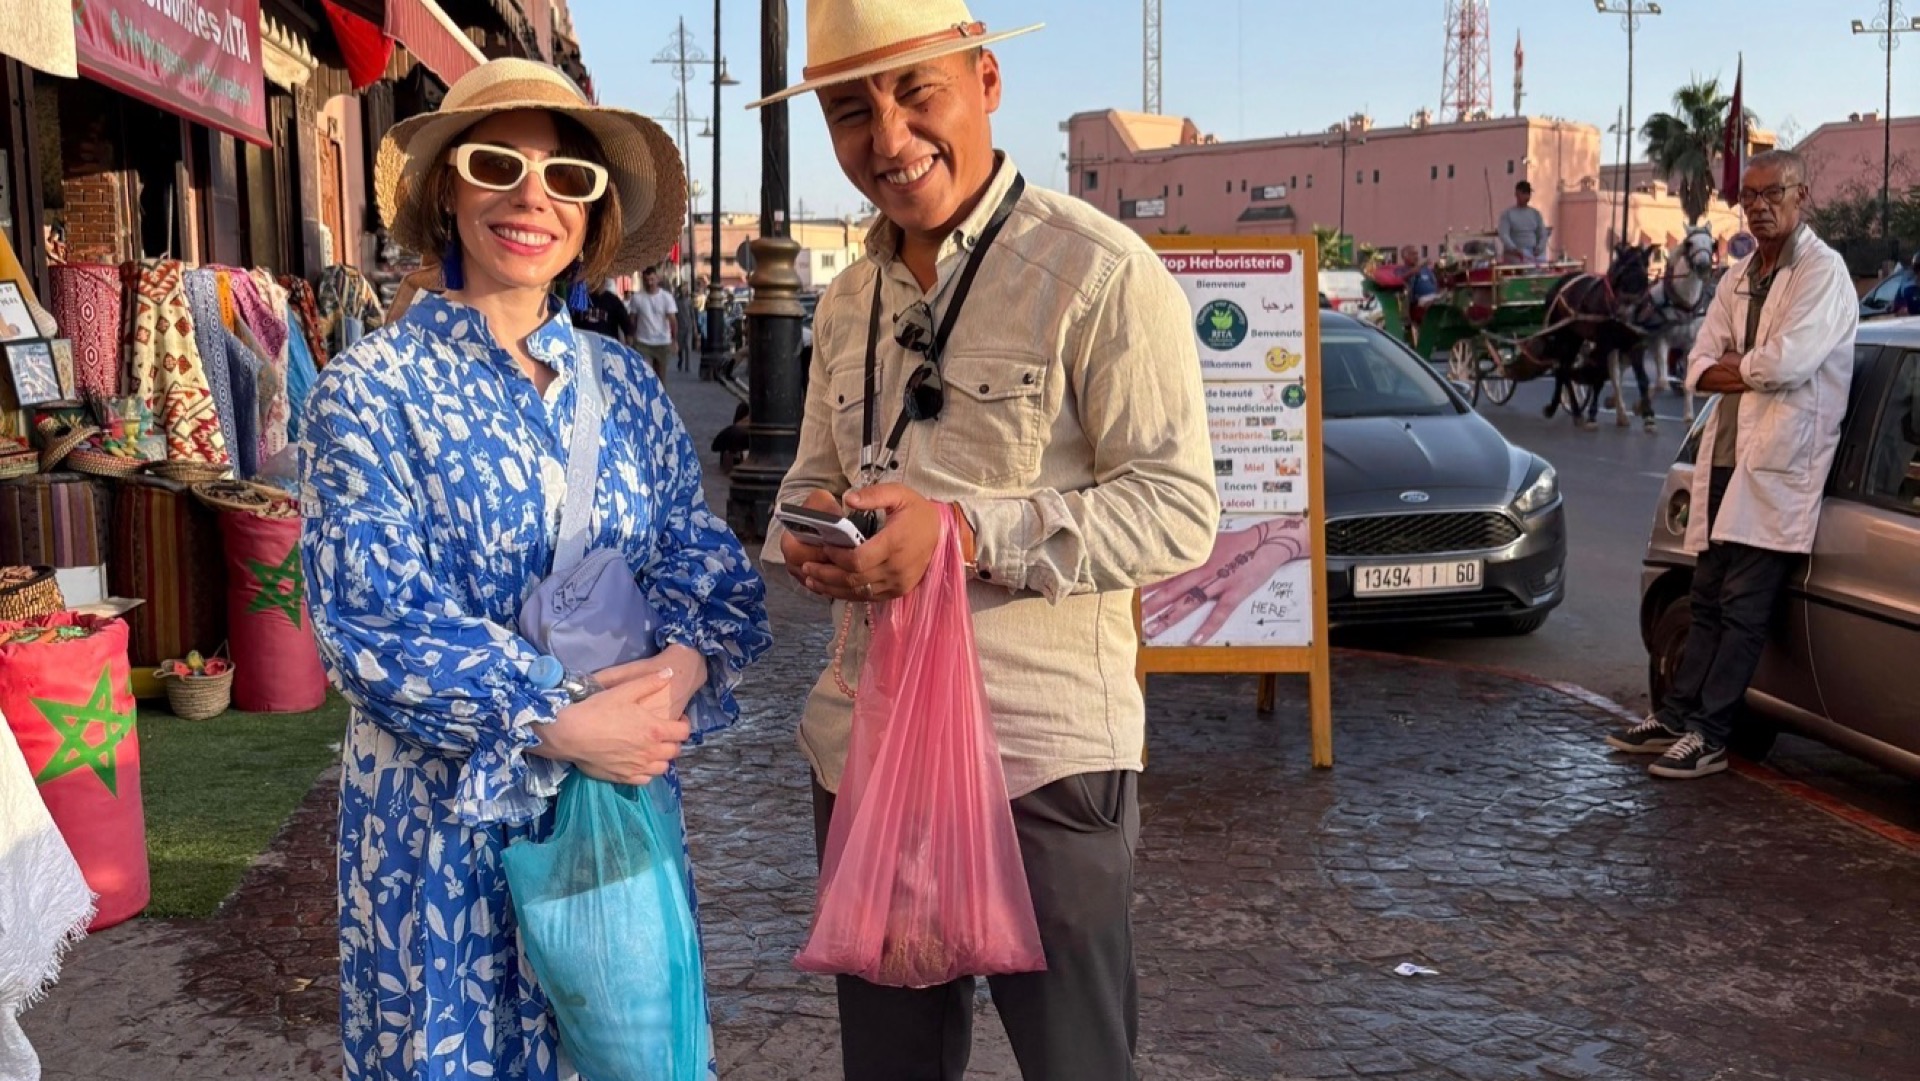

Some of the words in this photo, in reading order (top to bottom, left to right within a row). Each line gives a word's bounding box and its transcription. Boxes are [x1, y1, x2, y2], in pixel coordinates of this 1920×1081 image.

[1189, 255, 1285, 270] Herboristerie
[1196, 280, 1246, 289] Bienvenue
[1251, 329, 1302, 338] Benvenuto
[1206, 389, 1218, 398] de
[1220, 389, 1253, 398] beauté
[1227, 403, 1284, 413] médicinales
[1221, 445, 1250, 454] Savon
[1252, 444, 1294, 454] artisanal
[1244, 463, 1265, 472] Miel
[1224, 482, 1257, 491] Encens
[1226, 499, 1255, 508] alcool
[1364, 567, 1412, 589] 13494
[1456, 563, 1475, 583] 60
[1250, 600, 1287, 617] HERE
